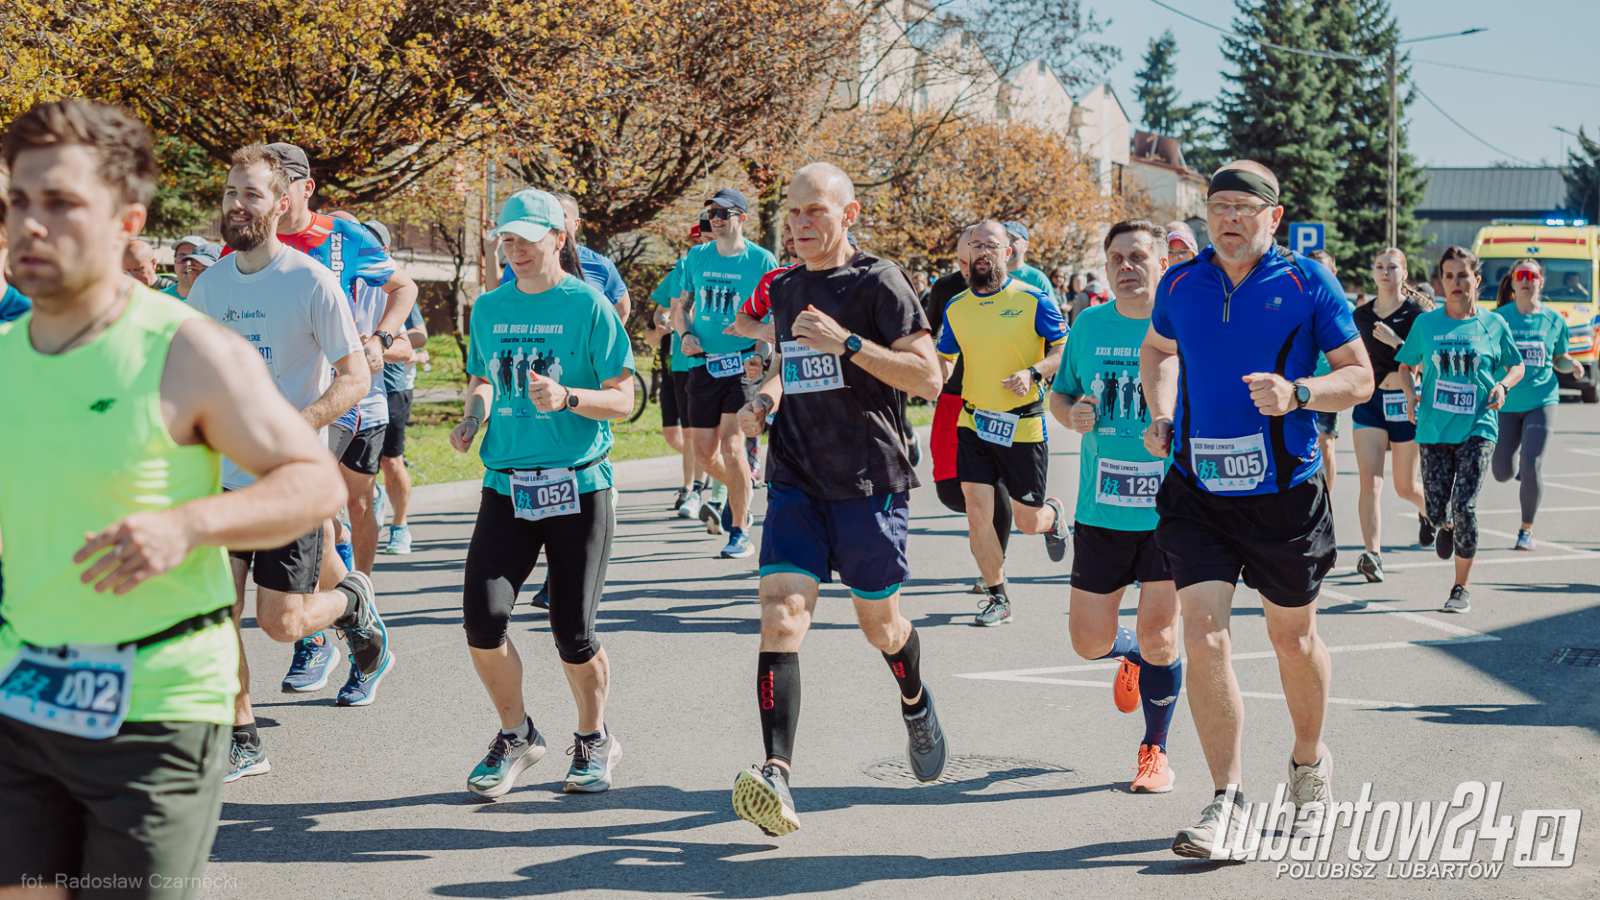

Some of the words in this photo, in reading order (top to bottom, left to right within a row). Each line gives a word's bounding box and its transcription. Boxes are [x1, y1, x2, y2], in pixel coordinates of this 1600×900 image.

[1297, 226, 1318, 255] P
[720, 357, 739, 370] 034
[802, 355, 834, 378] 038
[1453, 394, 1473, 406] 130
[988, 419, 1012, 436] 015
[1224, 453, 1262, 476] 005
[537, 482, 573, 506] 052
[1126, 476, 1159, 495] 129
